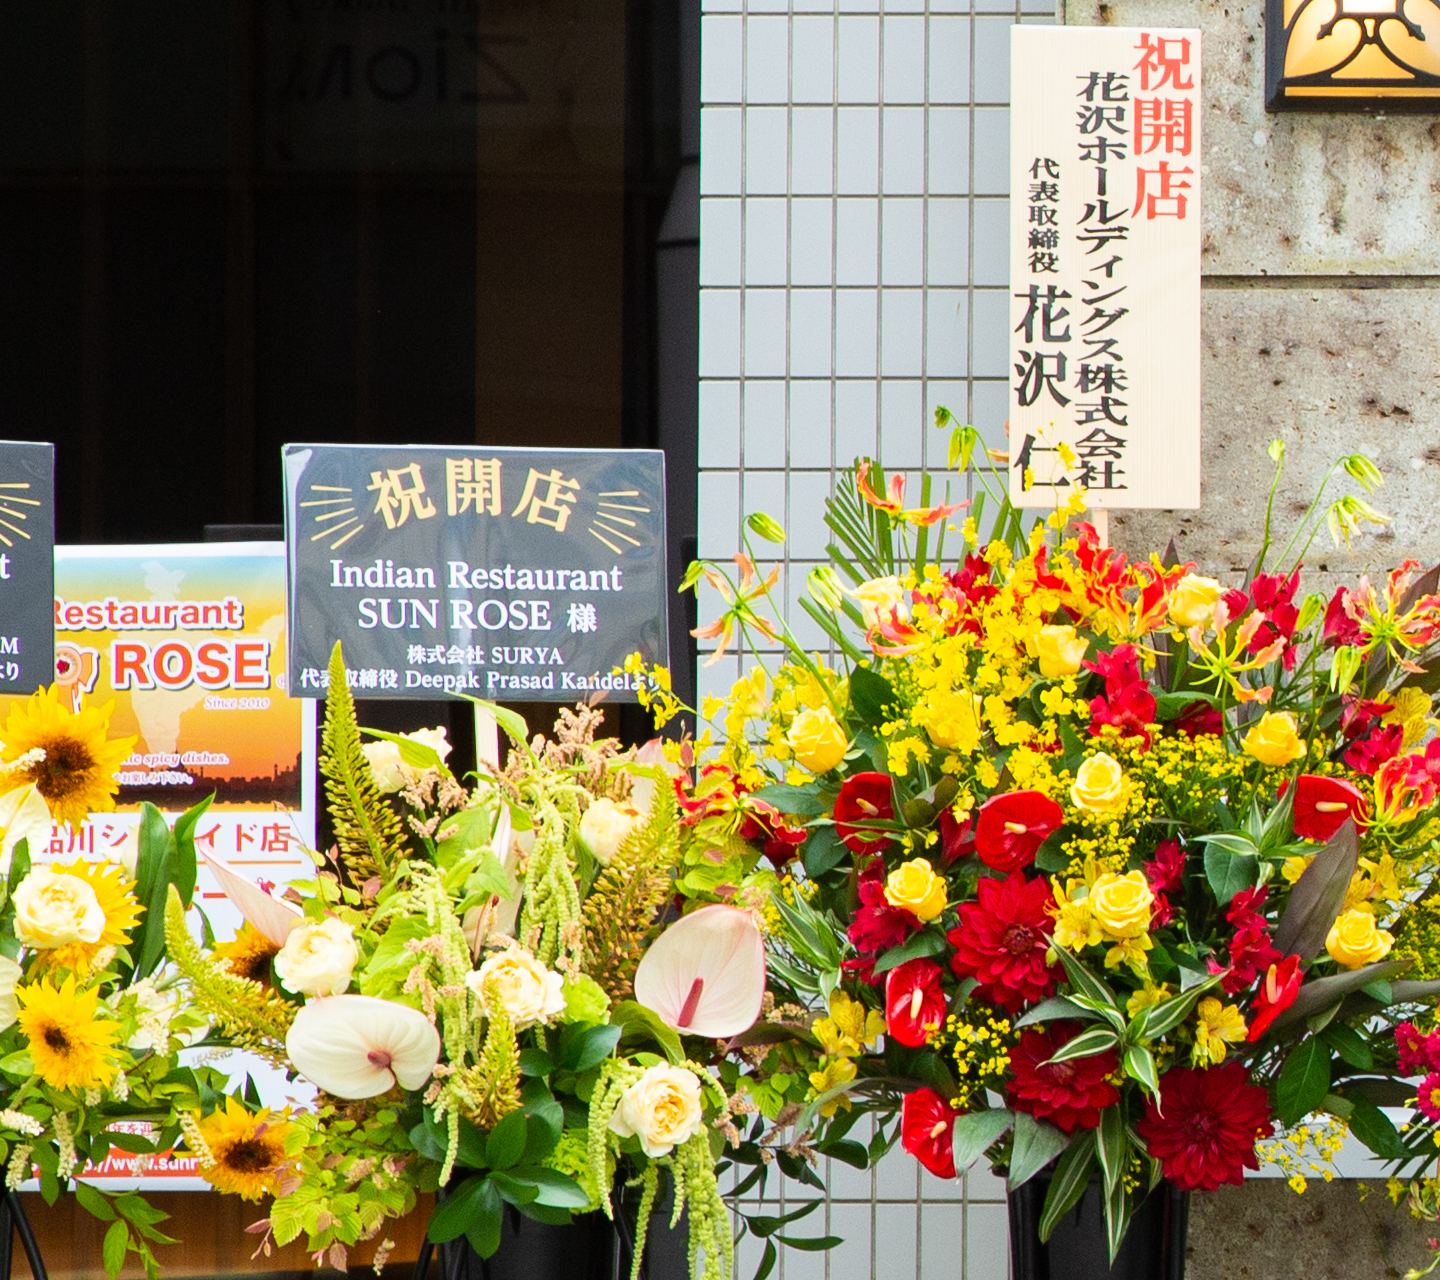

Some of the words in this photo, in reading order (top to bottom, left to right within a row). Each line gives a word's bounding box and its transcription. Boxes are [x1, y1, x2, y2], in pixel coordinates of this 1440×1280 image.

[1131, 32, 1195, 221] 祝開店
[1028, 158, 1060, 273] 代表取締役
[1074, 72, 1130, 491] 花沢ホールディングス株式会社
[1014, 284, 1073, 408] 花沢
[367, 457, 581, 532] 祝開店
[329, 558, 437, 589] Indian
[447, 560, 623, 591] Restaurant
[357, 598, 438, 631] SUN
[452, 599, 552, 631] ROSE
[566, 602, 598, 634] 様
[112, 639, 268, 687] ROSE
[406, 644, 486, 666] 株式会社
[491, 646, 565, 666] SURYA
[204, 696, 239, 710] Since
[405, 669, 481, 692] Deepak
[486, 670, 555, 691] Prasad
